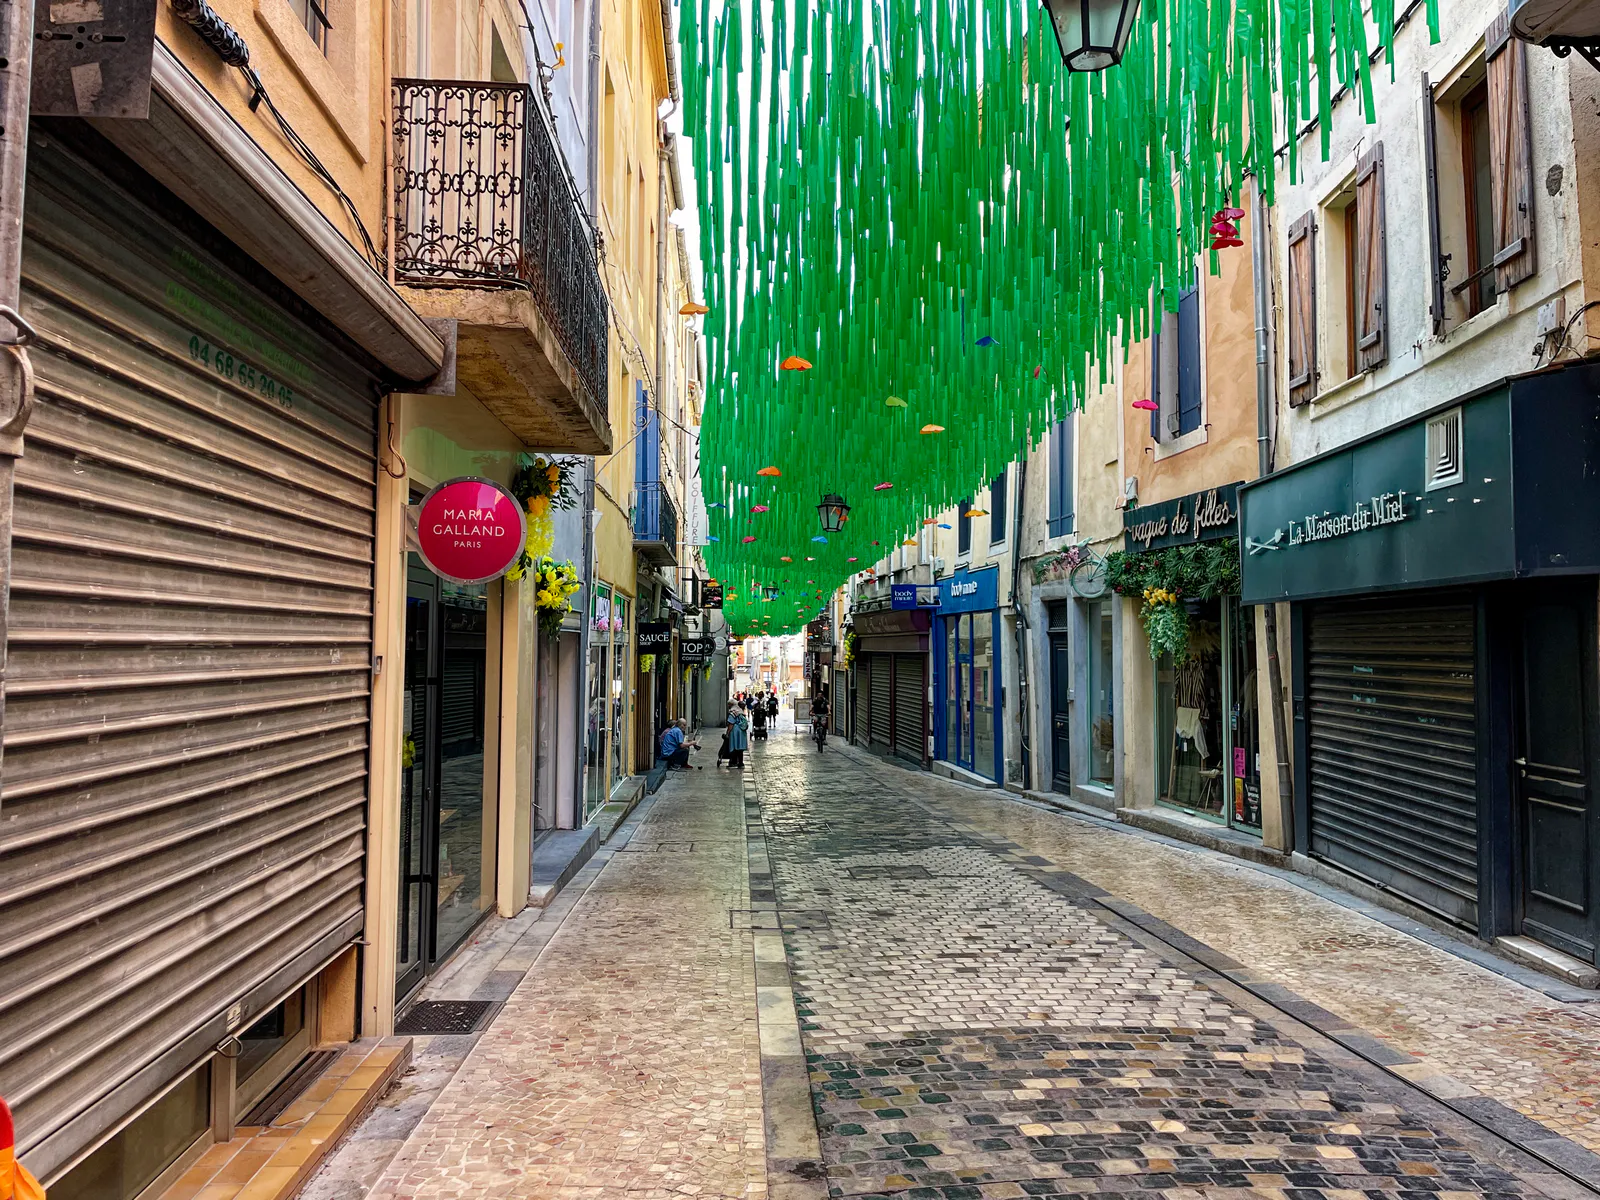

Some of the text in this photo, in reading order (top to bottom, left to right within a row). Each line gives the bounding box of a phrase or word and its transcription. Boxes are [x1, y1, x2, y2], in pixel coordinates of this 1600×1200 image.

[189, 335, 210, 367] 04
[215, 350, 234, 379] 68
[238, 363, 256, 390] 65
[278, 386, 293, 409] 05
[443, 509, 494, 521] MARIA
[691, 481, 699, 544] COIFFURE
[1130, 489, 1235, 548] vague de filles
[1288, 489, 1405, 546] La Maison du Miel
[432, 524, 505, 537] GALLAND
[454, 540, 481, 549] PARIS
[639, 633, 669, 642] SAUCE
[682, 642, 703, 653] TOP
